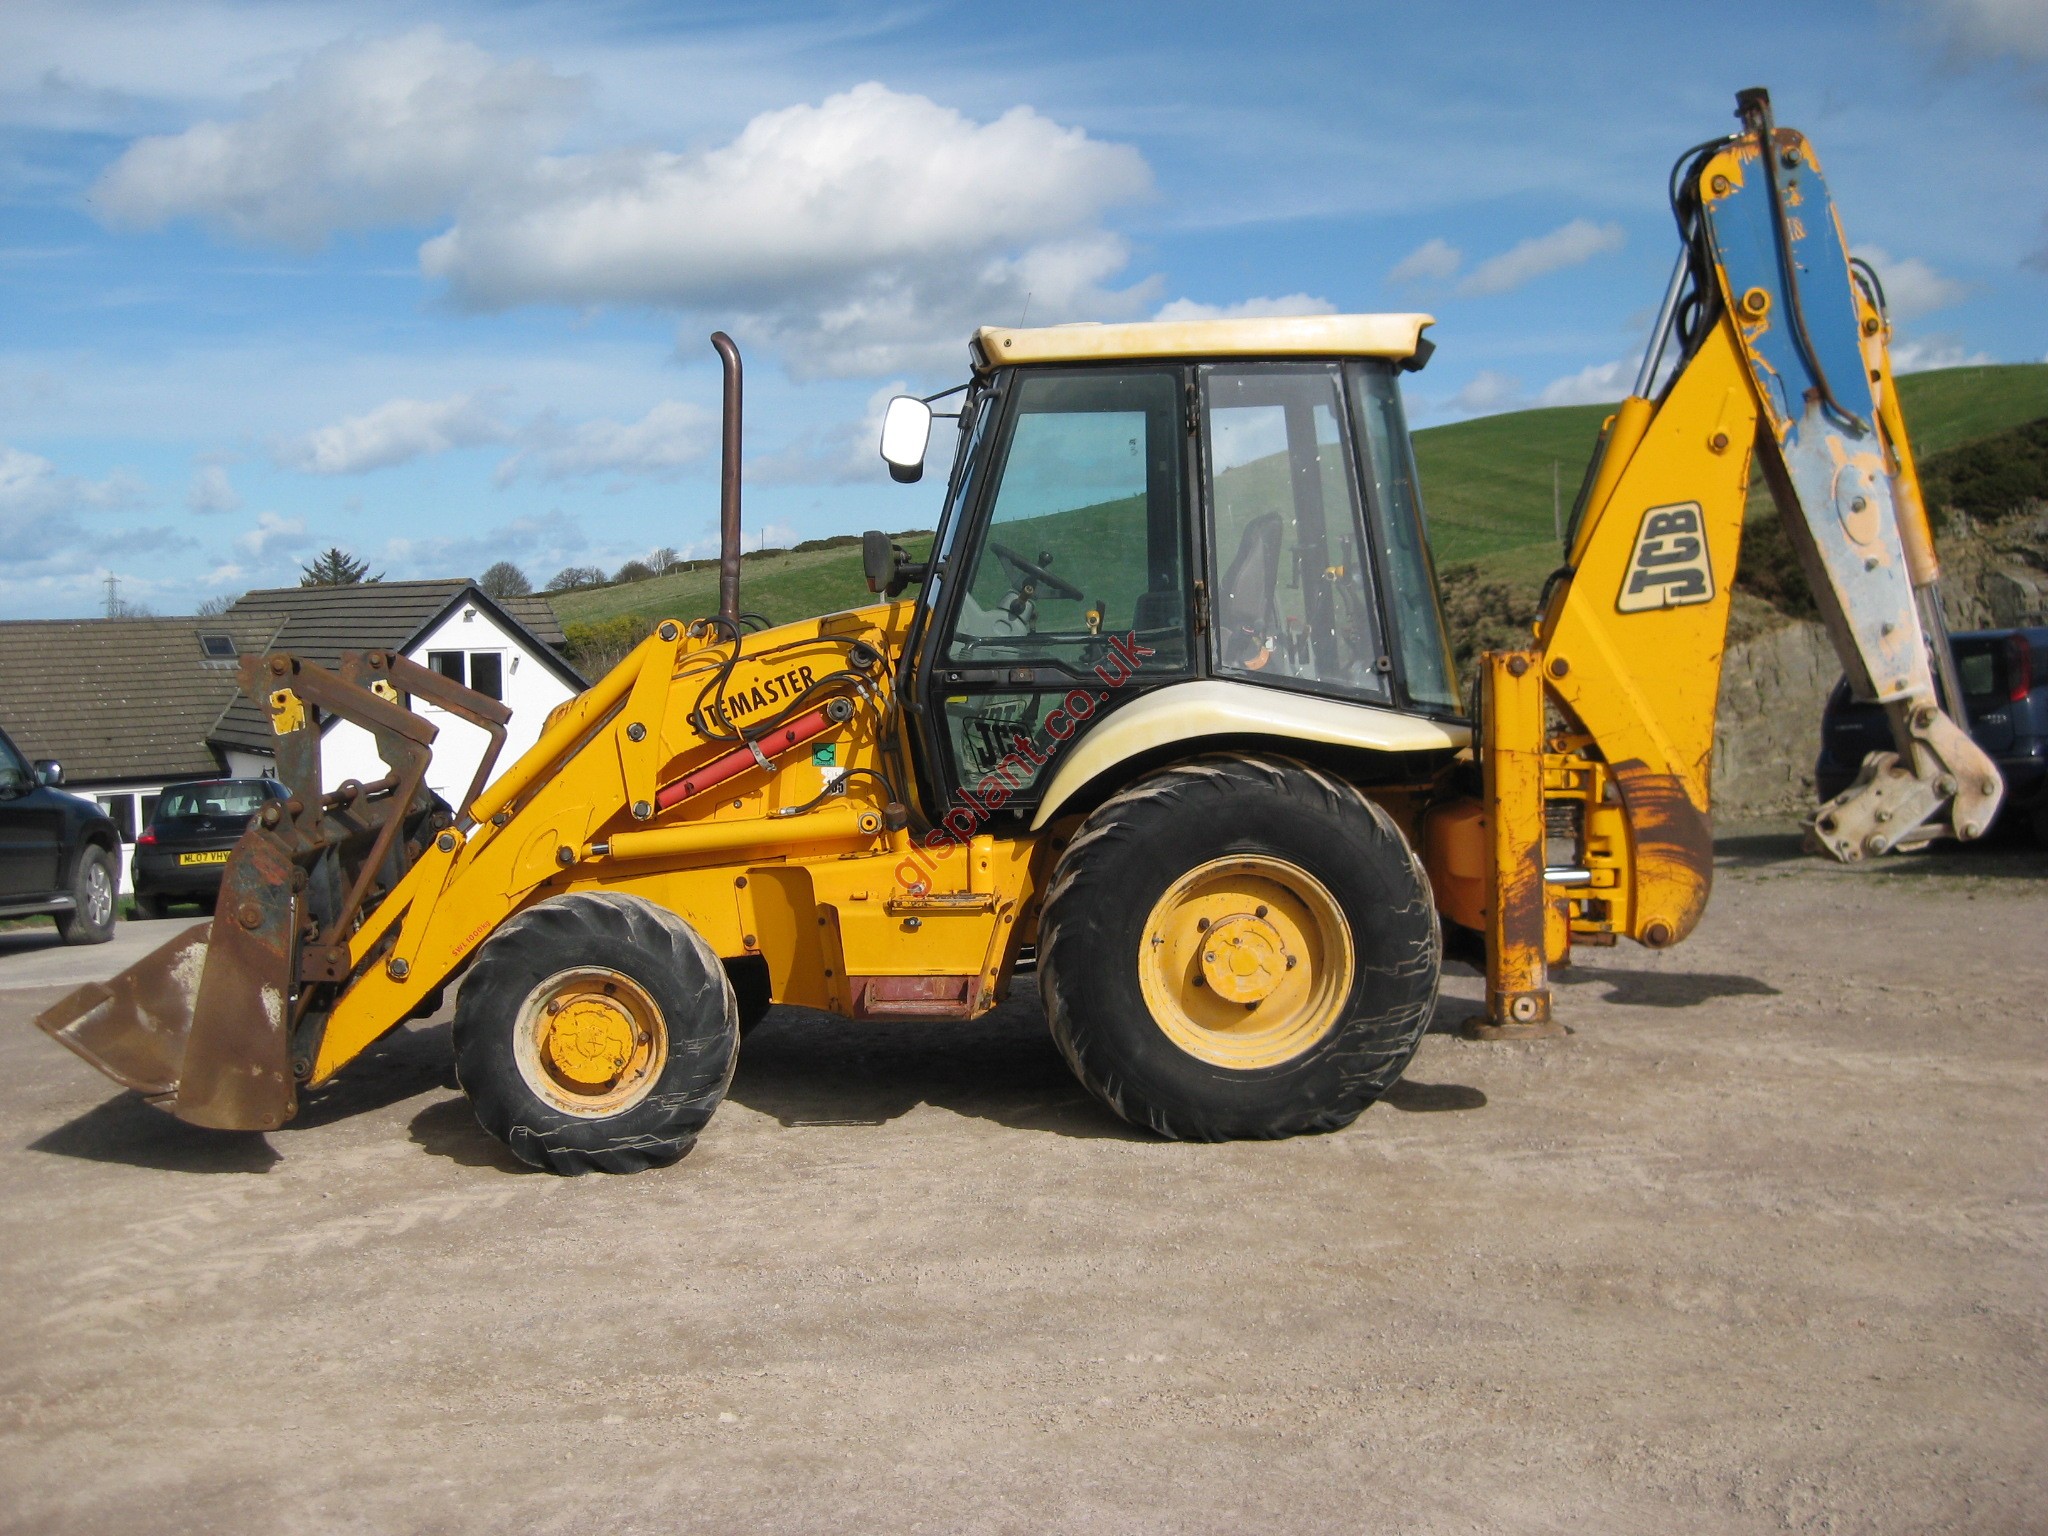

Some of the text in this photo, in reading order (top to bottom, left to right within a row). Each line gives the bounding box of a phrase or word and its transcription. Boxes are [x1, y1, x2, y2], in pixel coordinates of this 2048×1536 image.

[1628, 509, 1706, 597] JCB
[184, 853, 208, 863] ML07
[452, 942, 467, 957] SWL
